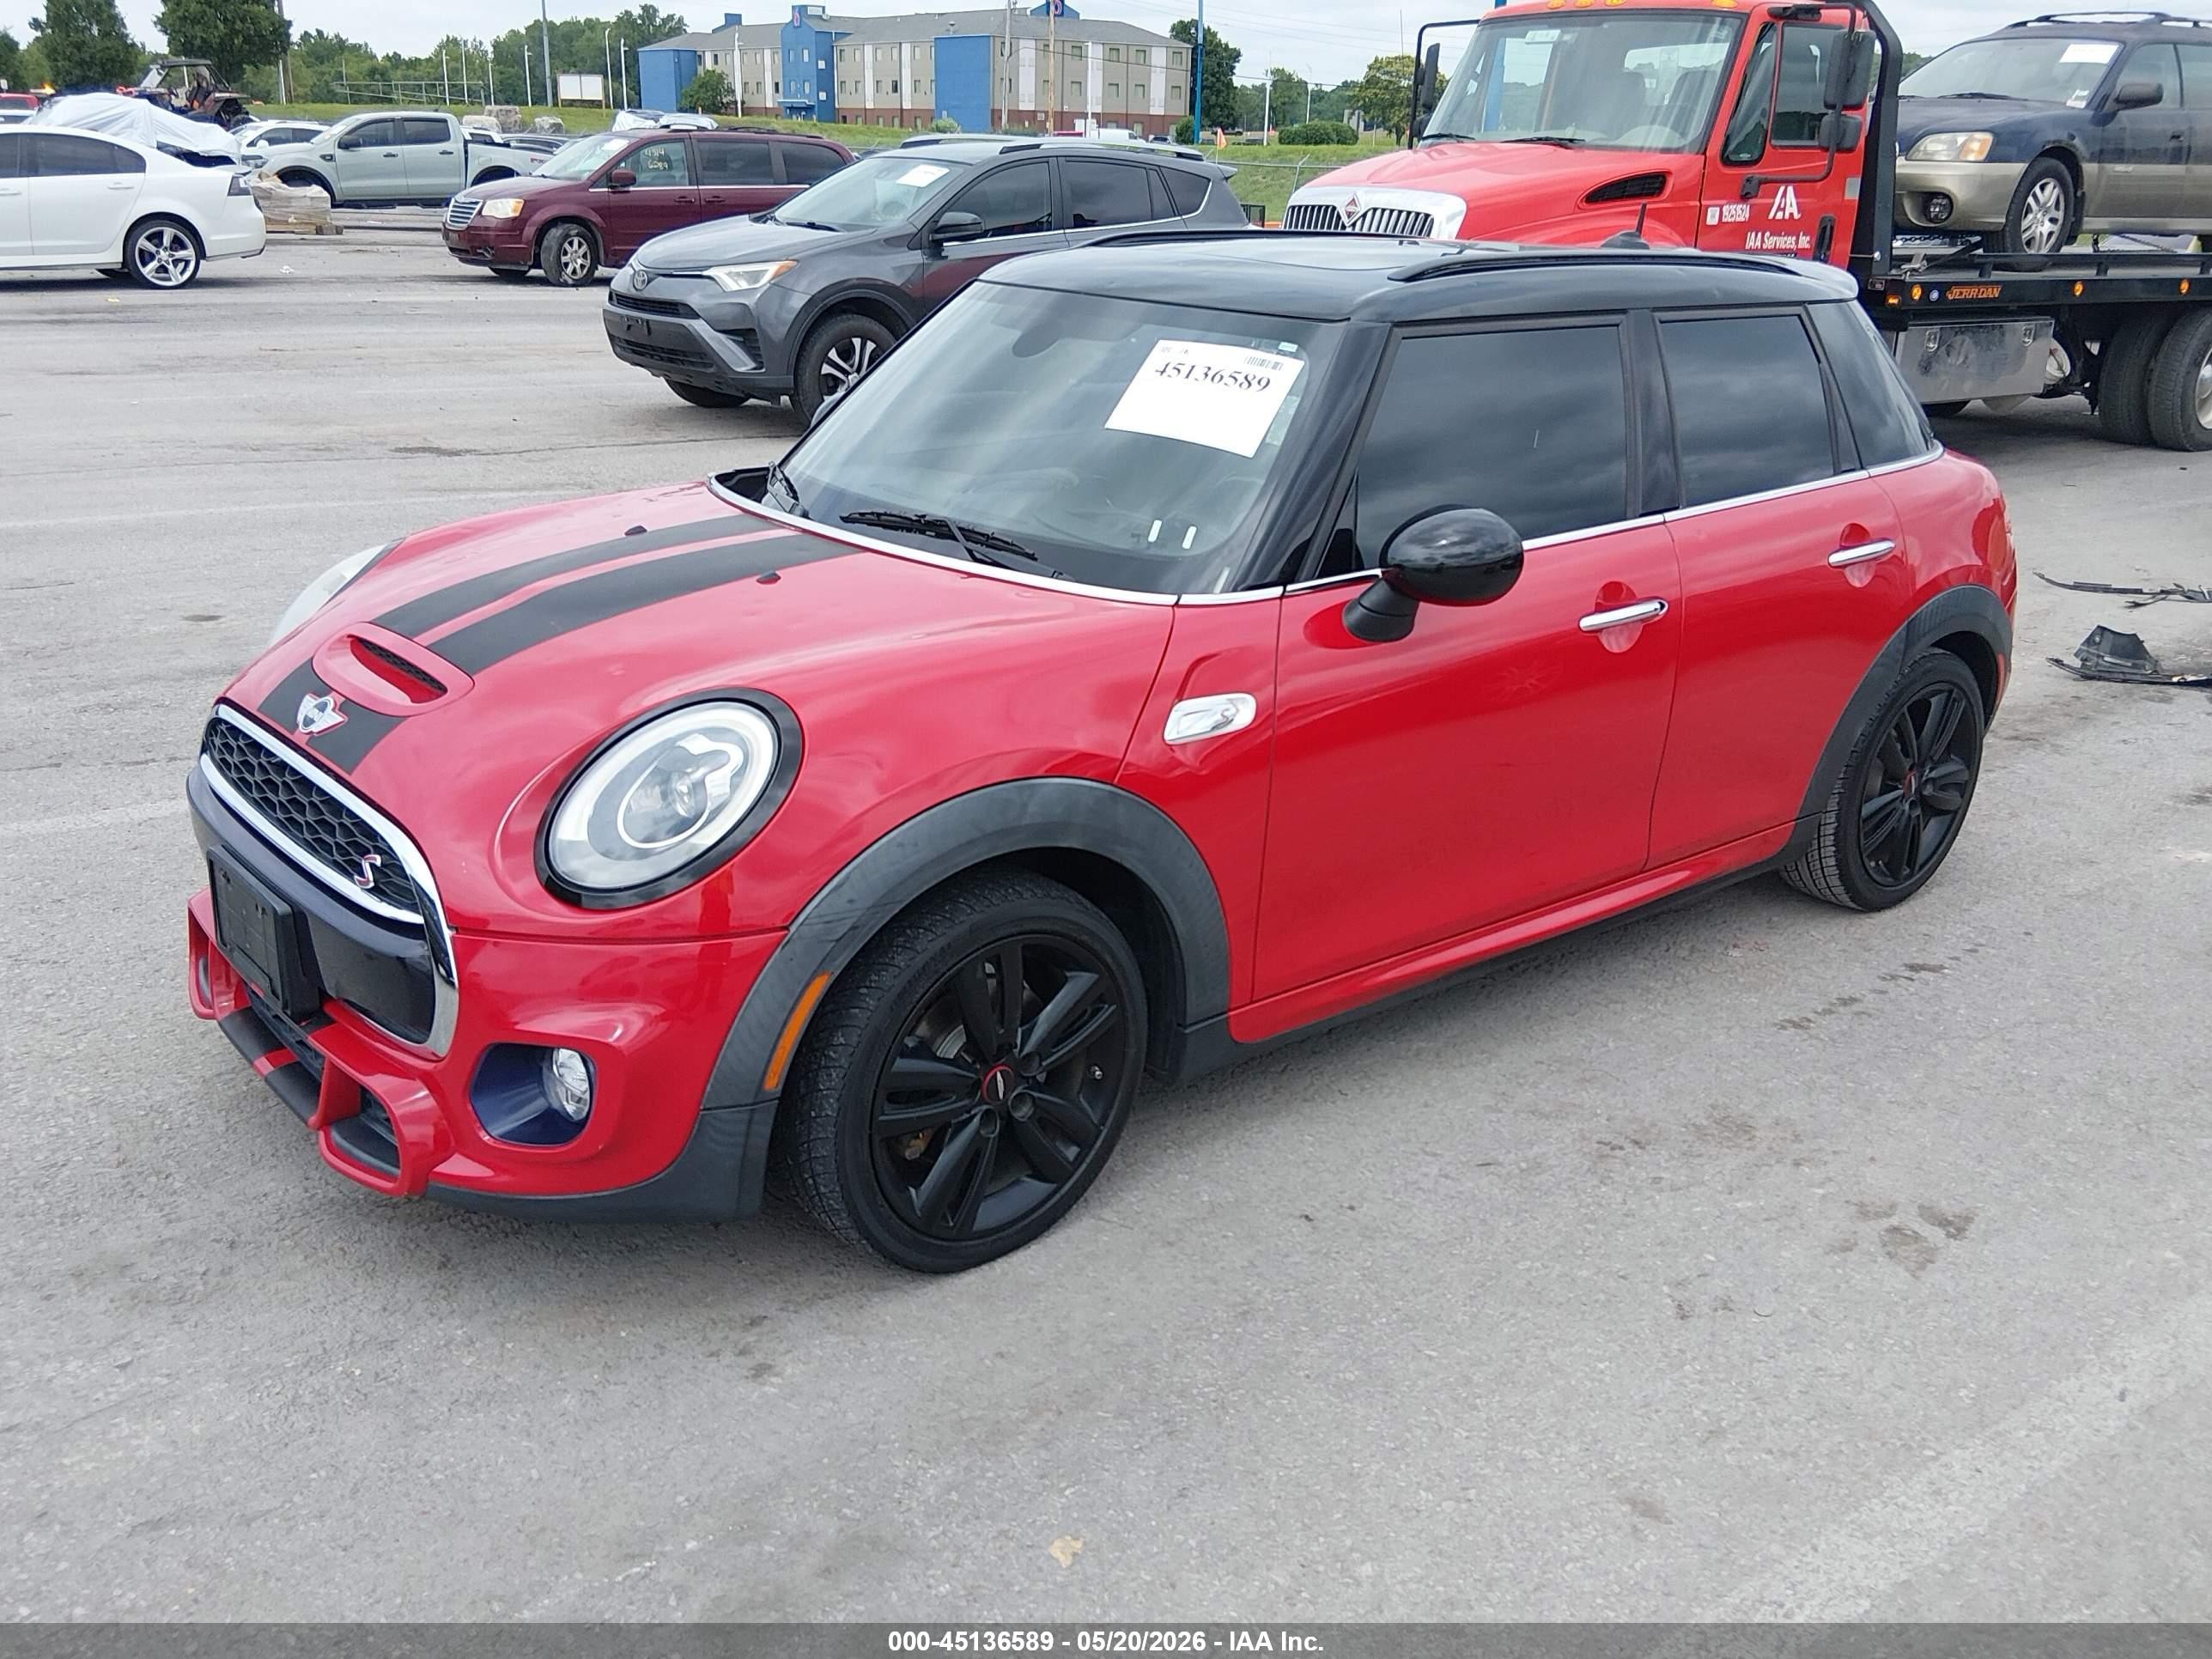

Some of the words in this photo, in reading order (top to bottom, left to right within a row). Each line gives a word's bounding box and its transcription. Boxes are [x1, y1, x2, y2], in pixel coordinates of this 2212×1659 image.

[1745, 231, 1762, 249] IAA
[1763, 231, 1796, 250] Services,
[1797, 231, 1811, 249] Inc.
[1155, 361, 1271, 392] 45136589
[354, 854, 382, 889] S
